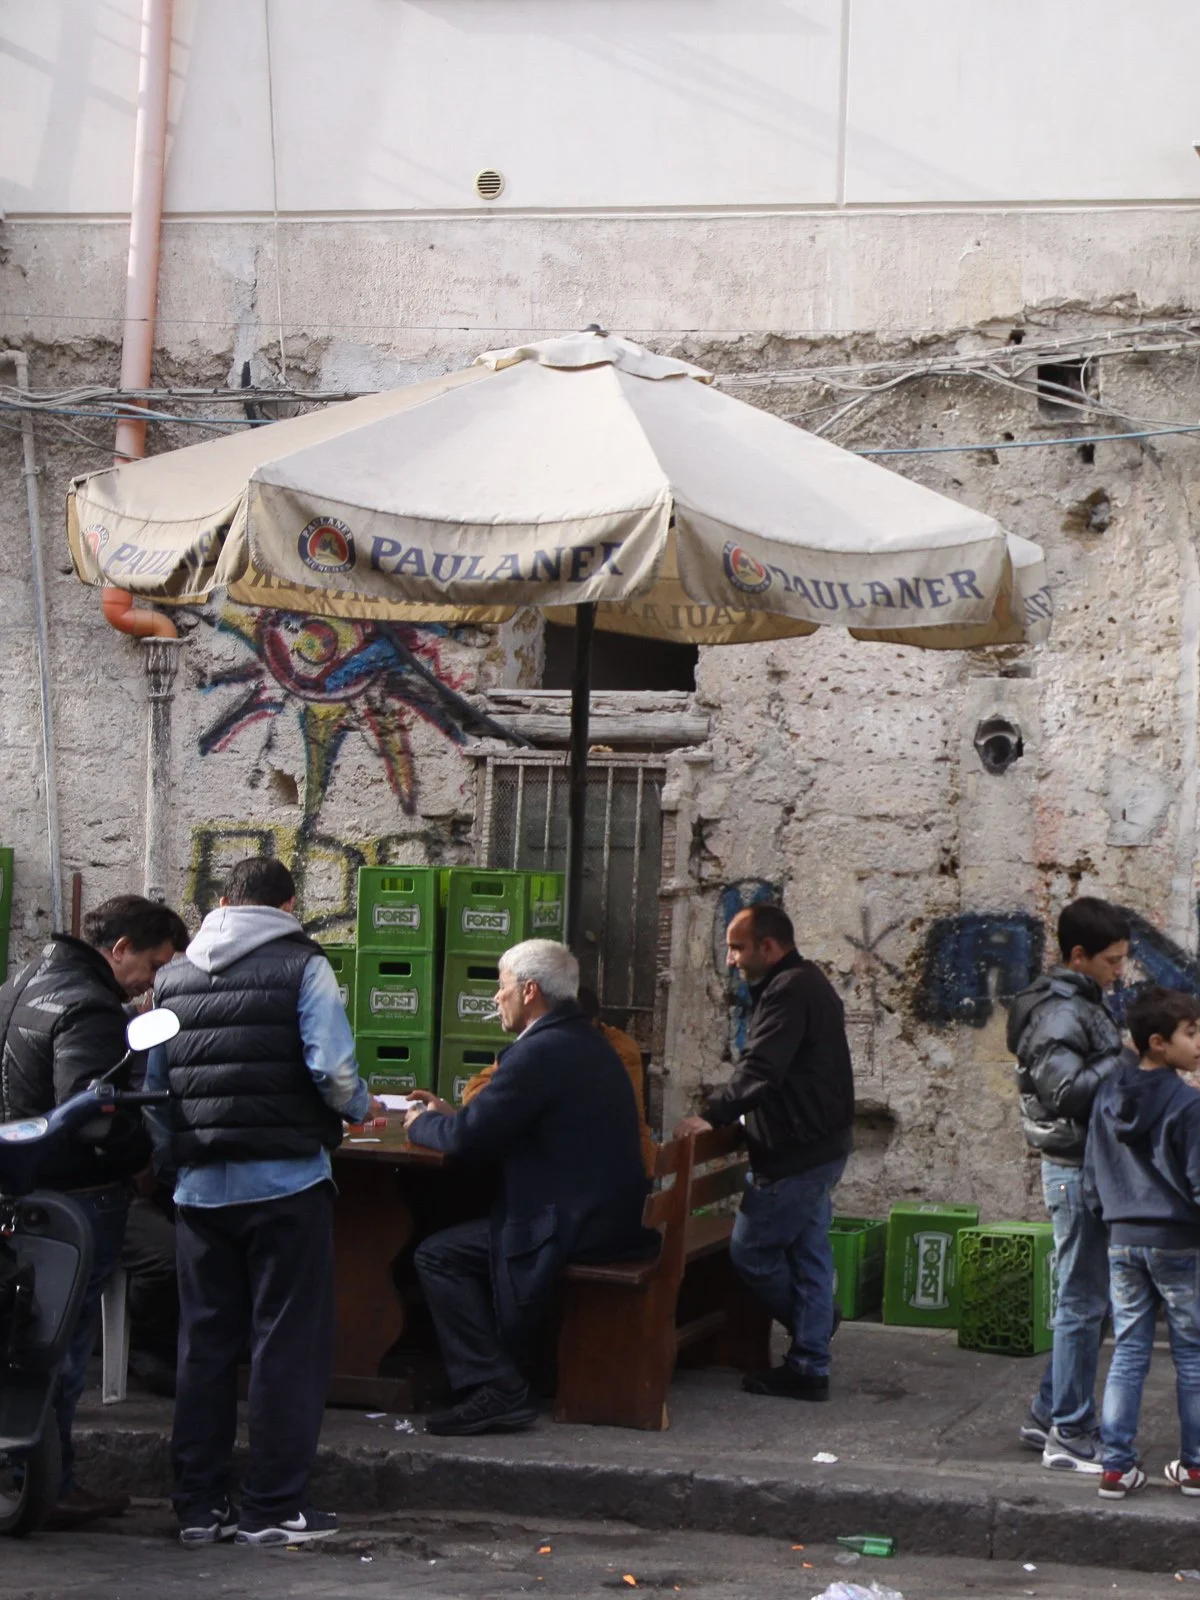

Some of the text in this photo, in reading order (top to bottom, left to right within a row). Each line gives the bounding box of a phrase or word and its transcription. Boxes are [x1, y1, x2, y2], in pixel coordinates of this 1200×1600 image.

[377, 910, 417, 923] FORST
[467, 914, 506, 929] FORST
[375, 995, 498, 1013] FORST FORS
[921, 1238, 941, 1304] FORST
